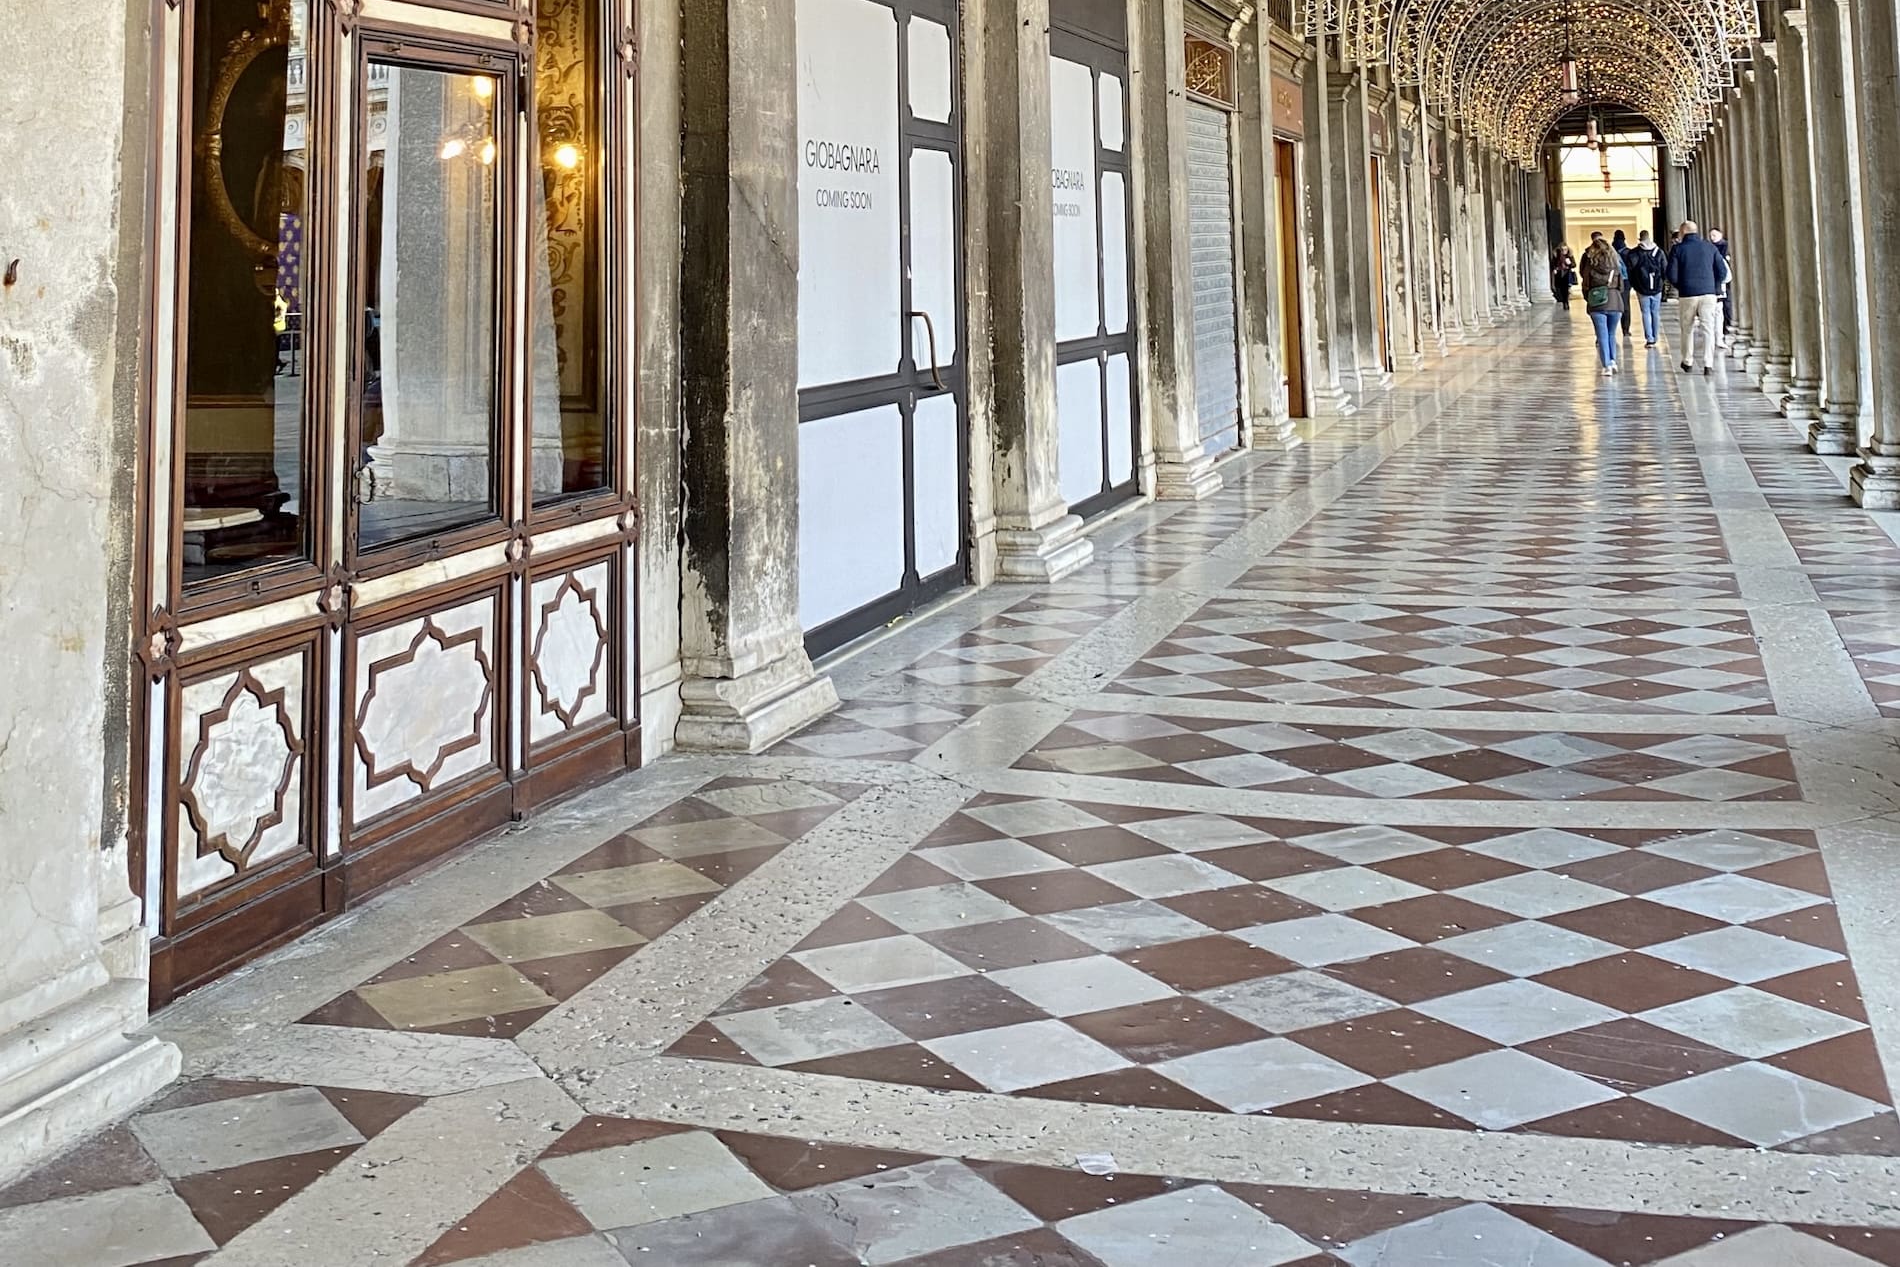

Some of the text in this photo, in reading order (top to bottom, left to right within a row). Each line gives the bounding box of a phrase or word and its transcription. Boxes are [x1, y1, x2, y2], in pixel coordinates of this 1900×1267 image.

[805, 140, 880, 174] GIOBAGNARA
[816, 189, 872, 210] COMING SOON
